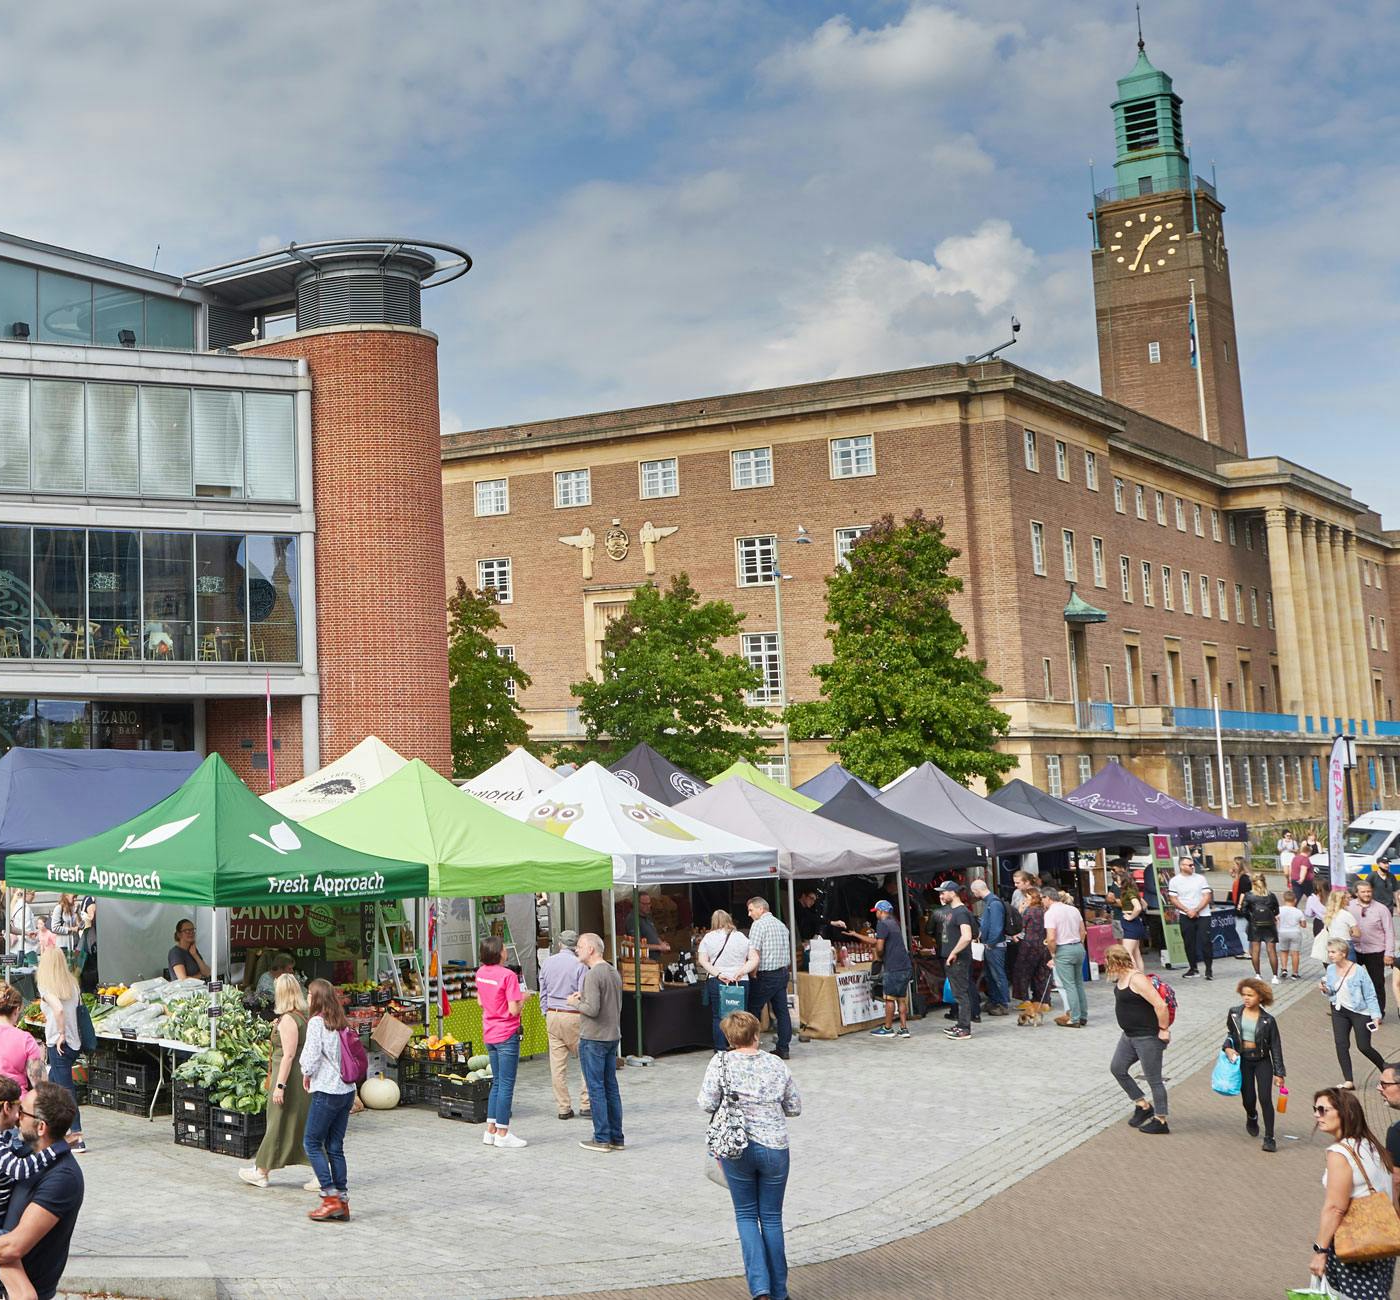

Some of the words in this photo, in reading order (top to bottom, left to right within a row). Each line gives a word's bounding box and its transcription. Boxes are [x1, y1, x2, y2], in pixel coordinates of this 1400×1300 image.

[1216, 827, 1239, 839] Vineyard
[46, 864, 84, 883] Fresh
[88, 865, 161, 890] Approach
[267, 873, 309, 893] Fresh
[313, 871, 385, 896] Approach
